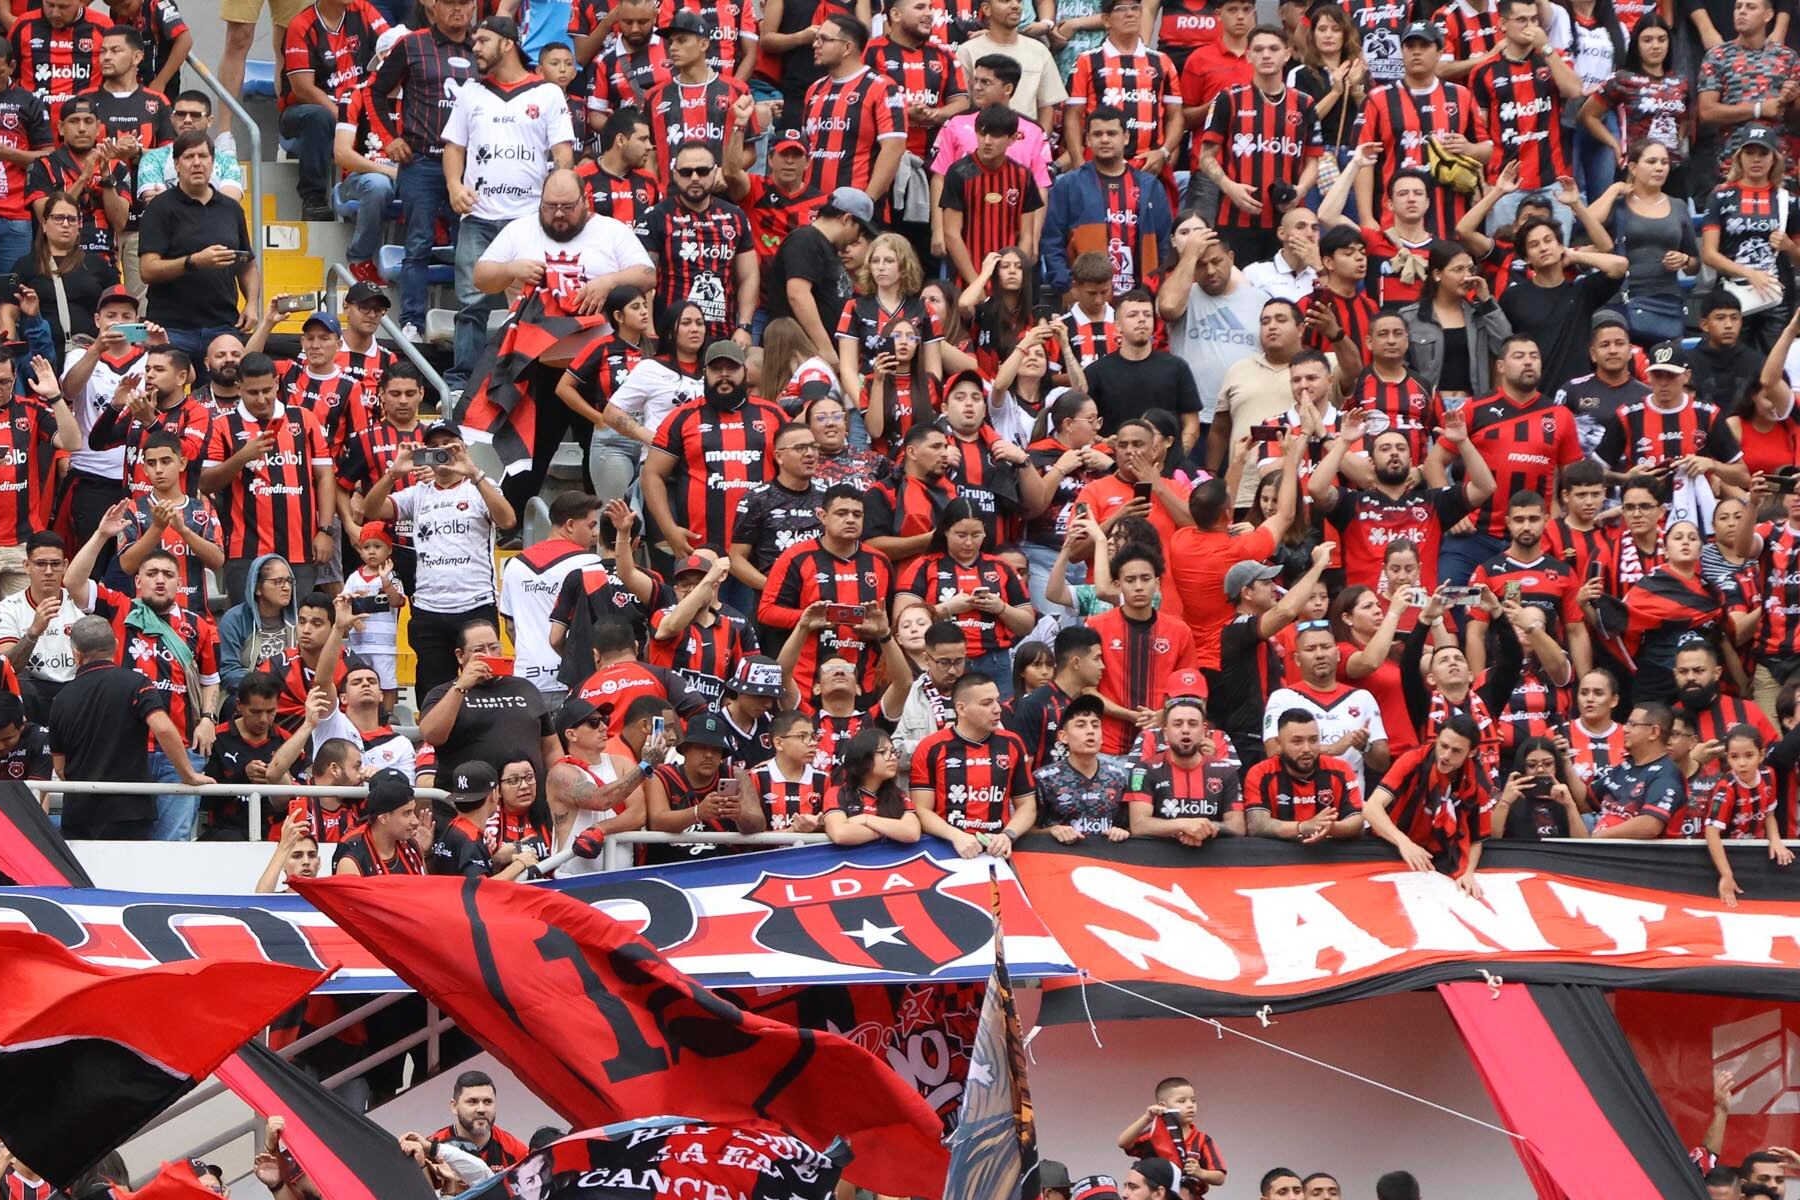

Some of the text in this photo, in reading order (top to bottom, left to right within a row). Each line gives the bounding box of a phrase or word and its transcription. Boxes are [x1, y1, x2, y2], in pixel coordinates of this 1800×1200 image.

[1177, 15, 1215, 29] ROJO
[1353, 6, 1404, 27] Tropical
[53, 65, 90, 79] kölbi
[818, 117, 850, 130] kölbi
[684, 123, 724, 140] kölbi
[494, 144, 536, 163] kölbi
[1257, 136, 1302, 157] kölbi
[1188, 325, 1258, 344] adidas
[373, 444, 397, 453] Mobil
[265, 452, 302, 467] kölbi
[706, 450, 760, 464] monge
[1508, 452, 1549, 464] movistar
[259, 485, 303, 496] medismart
[718, 479, 762, 489] medismart
[957, 485, 994, 500] Grupo
[435, 519, 470, 535] kölbi
[522, 581, 559, 595] Tropical
[958, 618, 994, 630] edismart
[618, 678, 654, 690] Pinos
[466, 695, 527, 708] LIMITS
[458, 776, 468, 789] NY
[1301, 796, 1316, 804] BAC
[1181, 800, 1218, 815] kölbi
[789, 872, 915, 903] LDA
[627, 1124, 715, 1150] HAY
